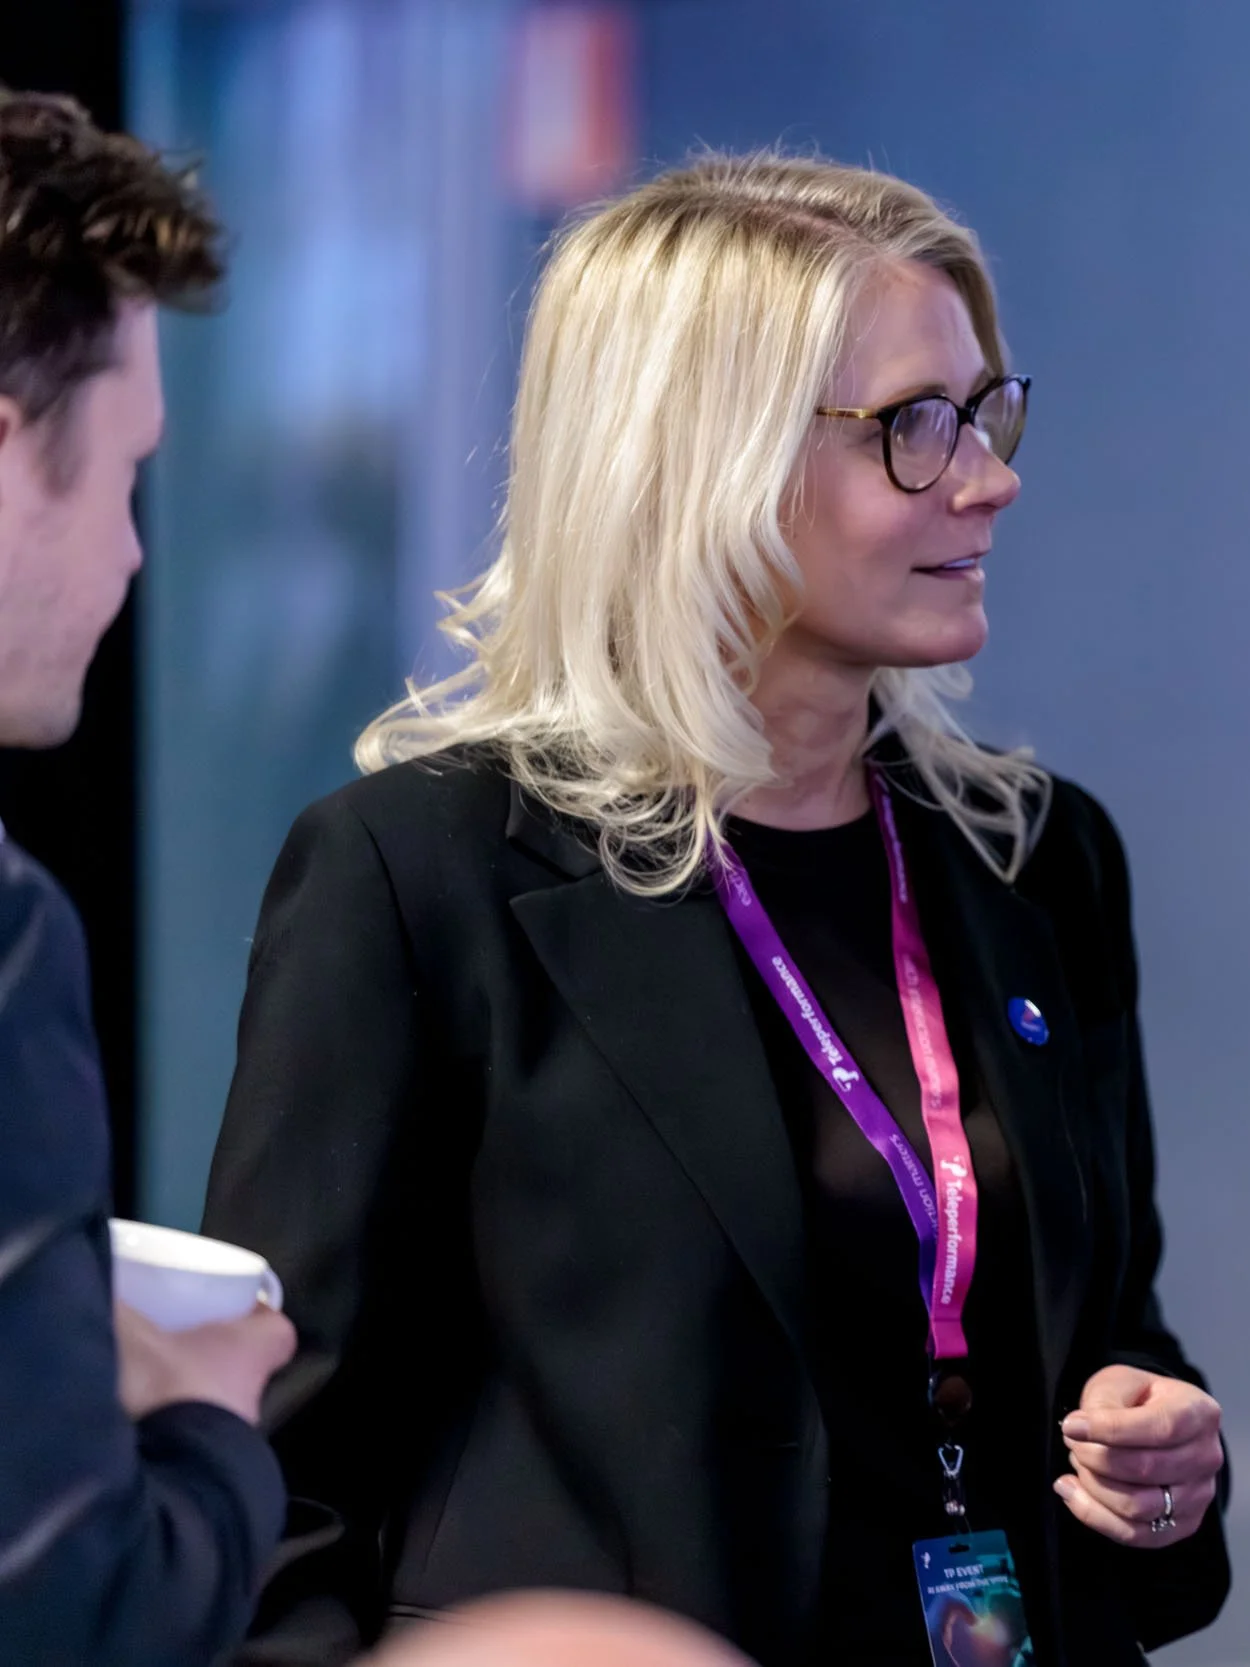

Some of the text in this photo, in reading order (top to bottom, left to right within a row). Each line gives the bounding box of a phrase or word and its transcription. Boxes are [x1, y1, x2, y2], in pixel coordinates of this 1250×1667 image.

[771, 956, 843, 1066] Teleperformance
[889, 1133, 924, 1188] matters
[940, 1179, 963, 1305] Teleperformance
[944, 1564, 984, 1578] TP EVENT
